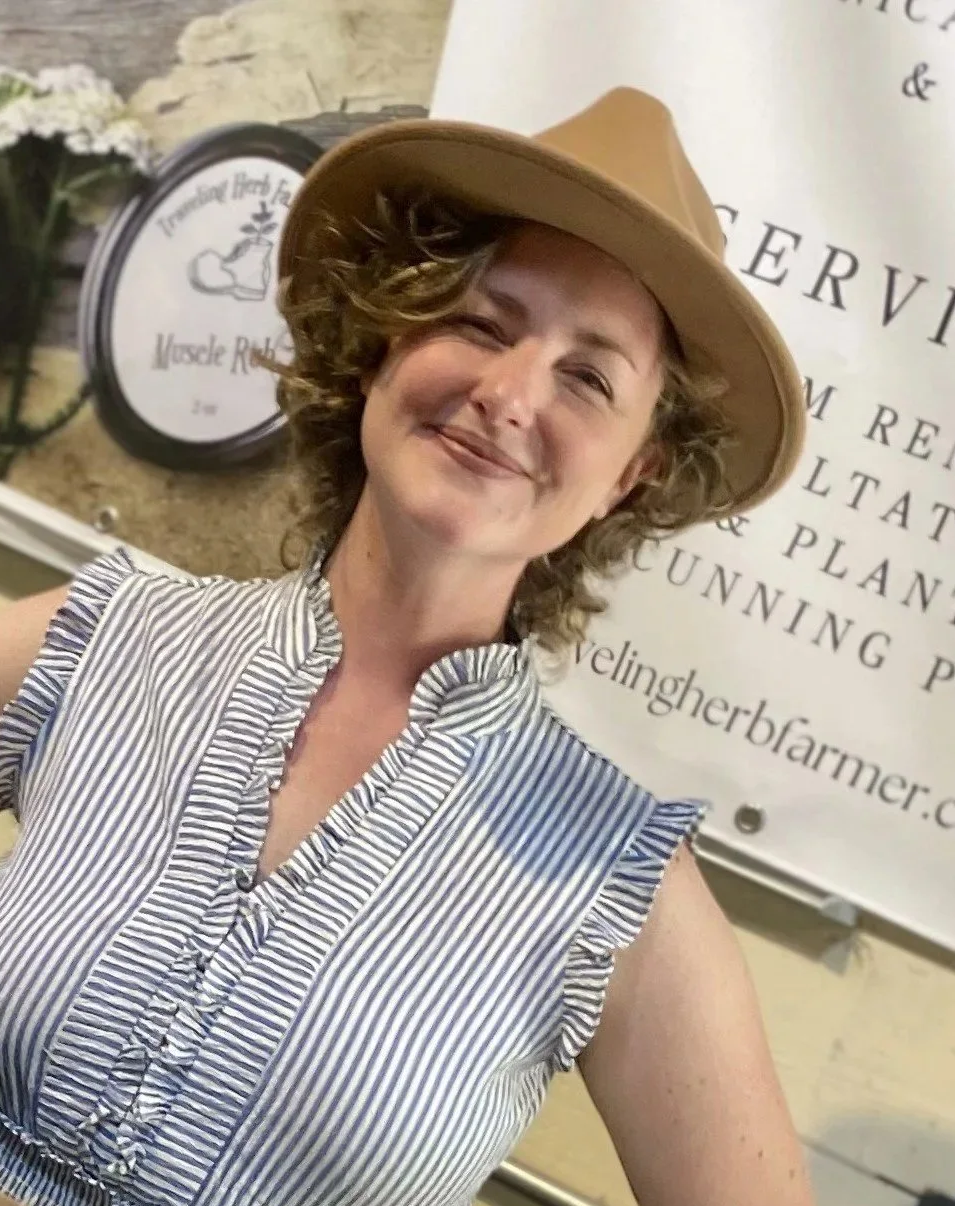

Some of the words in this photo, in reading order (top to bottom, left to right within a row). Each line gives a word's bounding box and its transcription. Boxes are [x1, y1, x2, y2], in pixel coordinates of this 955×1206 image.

[901, 61, 937, 102] &
[151, 332, 227, 371] Muscle
[631, 537, 893, 670] CUNNING
[781, 522, 955, 629] PLAN
